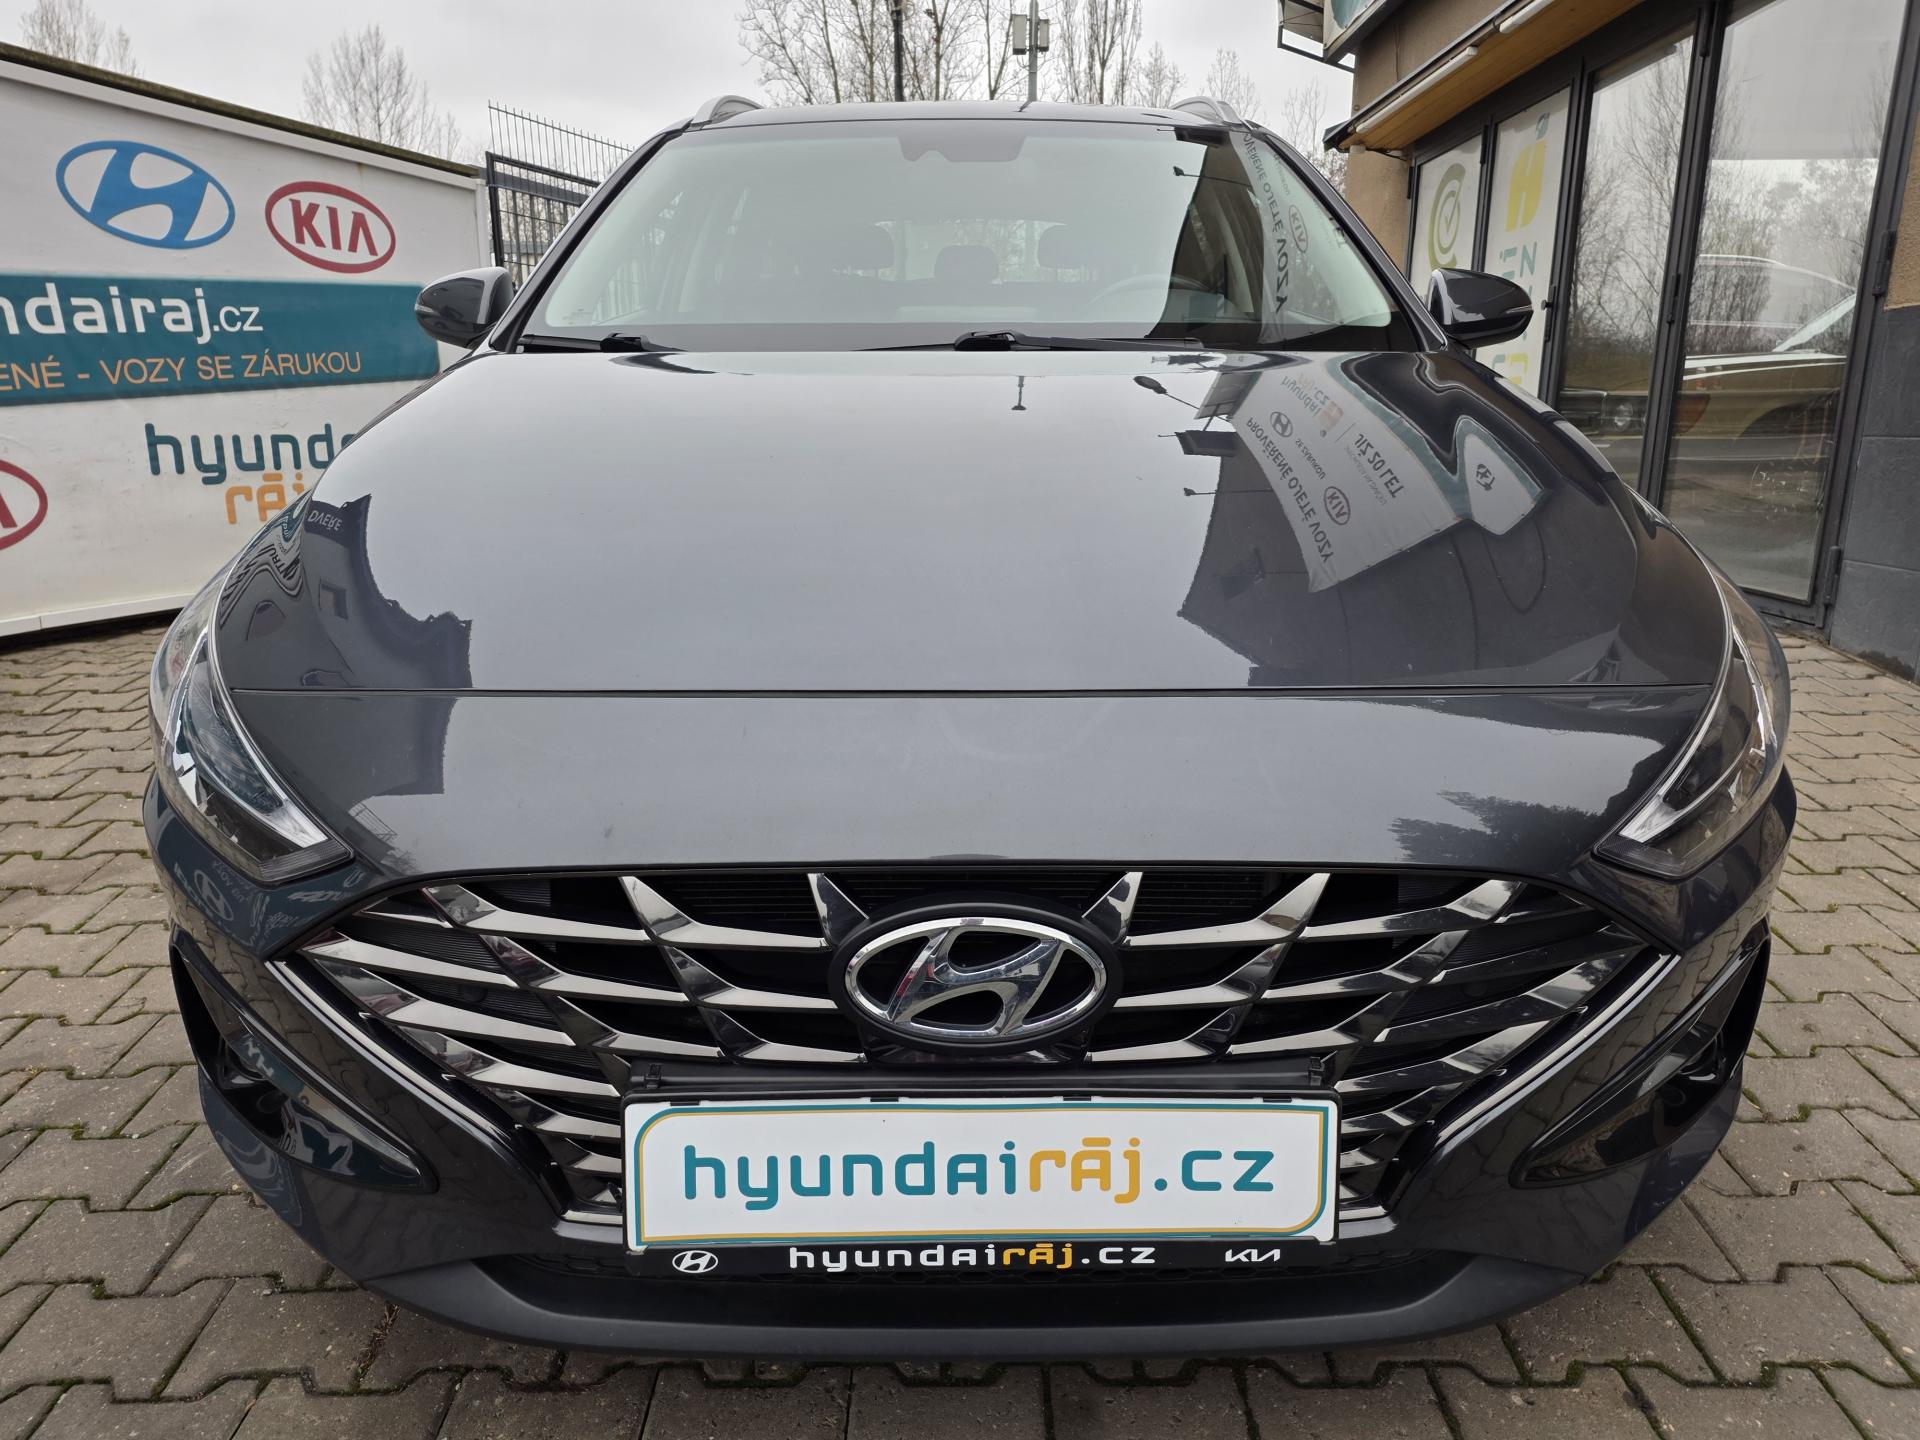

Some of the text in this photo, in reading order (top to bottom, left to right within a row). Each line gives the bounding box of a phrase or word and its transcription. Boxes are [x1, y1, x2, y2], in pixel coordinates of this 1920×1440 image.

[288, 197, 379, 257] KIA
[99, 356, 186, 385] VOZY
[196, 355, 234, 381] SE
[240, 348, 361, 378] ZÁRUKOU
[144, 422, 358, 486] hyund
